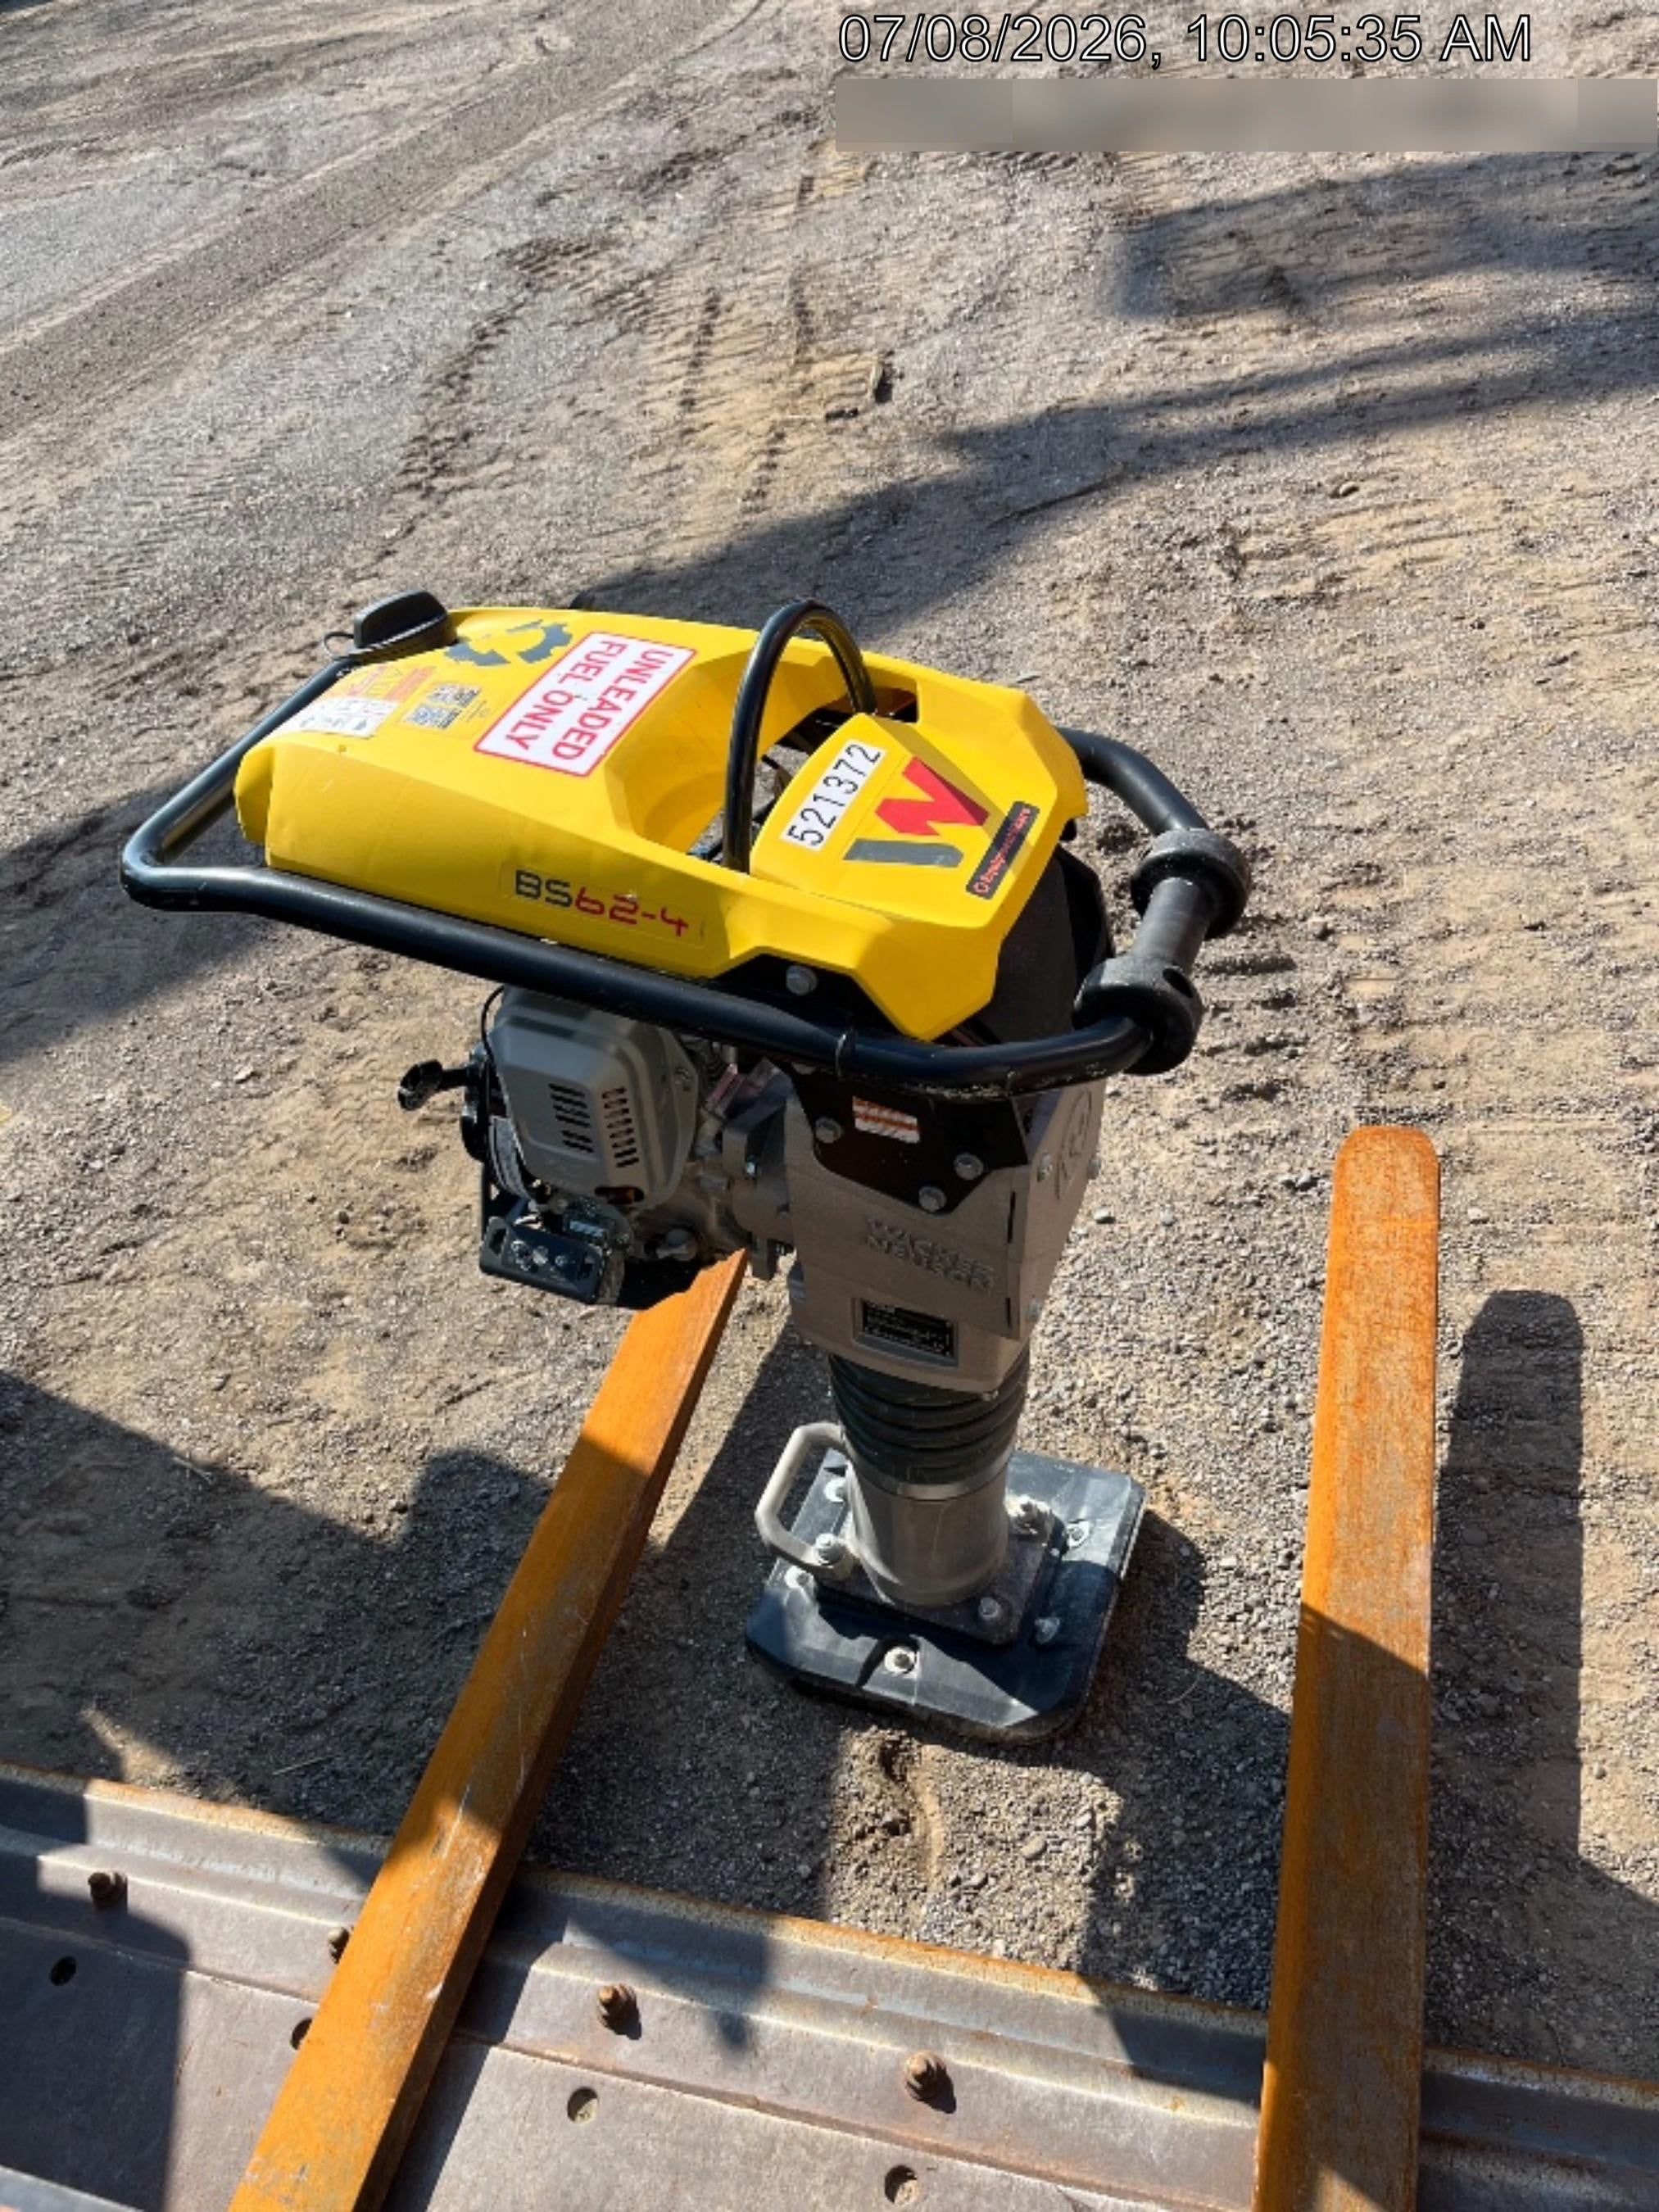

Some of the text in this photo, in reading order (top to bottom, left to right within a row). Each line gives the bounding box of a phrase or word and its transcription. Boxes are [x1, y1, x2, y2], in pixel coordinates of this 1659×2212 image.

[505, 641, 628, 750] FUEL ONLY
[552, 649, 673, 759] UNLEADED
[786, 744, 882, 845] 521372
[515, 869, 688, 936] BS62-4
